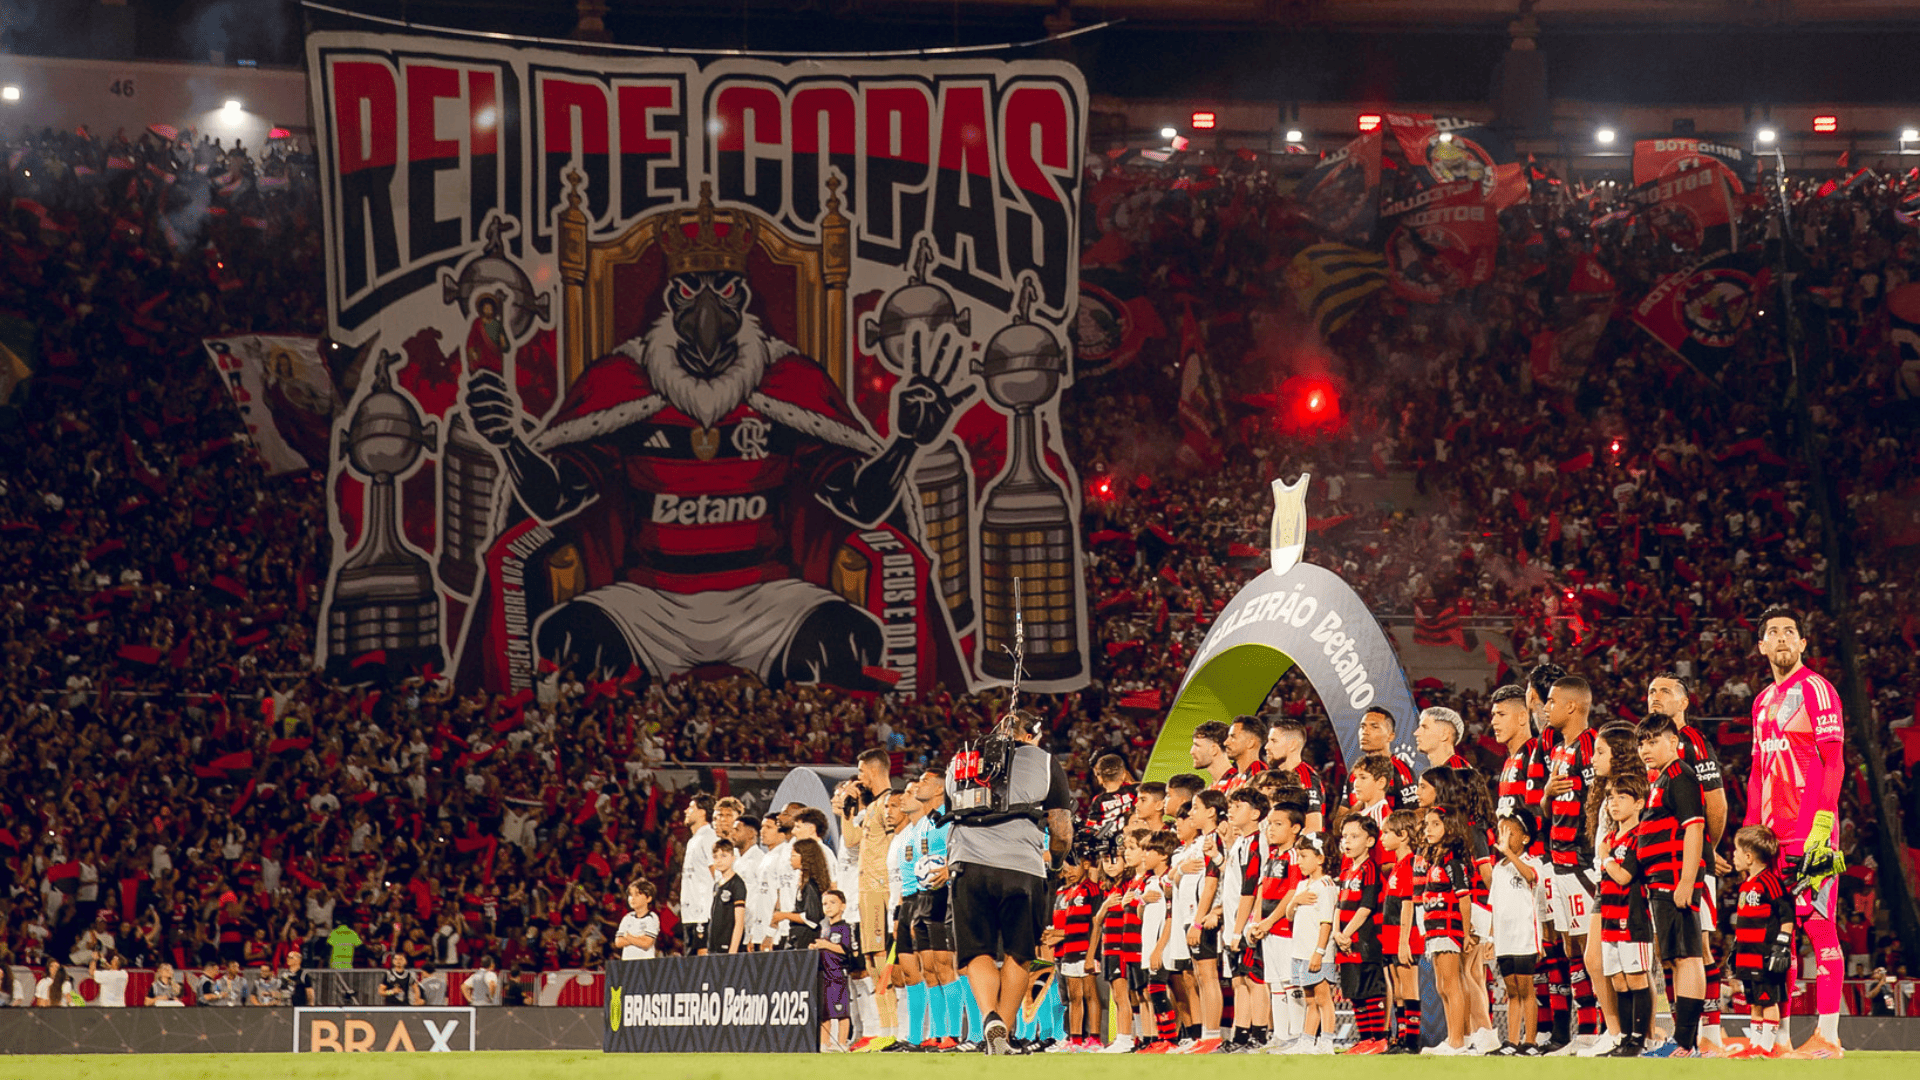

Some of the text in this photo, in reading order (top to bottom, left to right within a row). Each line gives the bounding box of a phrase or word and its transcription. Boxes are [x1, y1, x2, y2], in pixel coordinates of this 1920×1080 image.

[110, 79, 134, 97] 46
[330, 59, 1068, 308] REI DE COPAS
[652, 493, 767, 525] Betano
[858, 530, 906, 551] DE
[501, 555, 525, 586] NOS
[883, 553, 917, 603] DEUS
[502, 587, 529, 636] MORRE
[883, 606, 917, 619] E
[886, 623, 917, 648] DO
[1309, 609, 1375, 710] Betano
[1816, 713, 1838, 727] 12.12
[1695, 761, 1717, 774] 12.12
[1568, 894, 1585, 917] 16
[623, 982, 810, 1027] BRASILEIRÃO Betano 2025
[311, 1018, 460, 1052] BRAX
